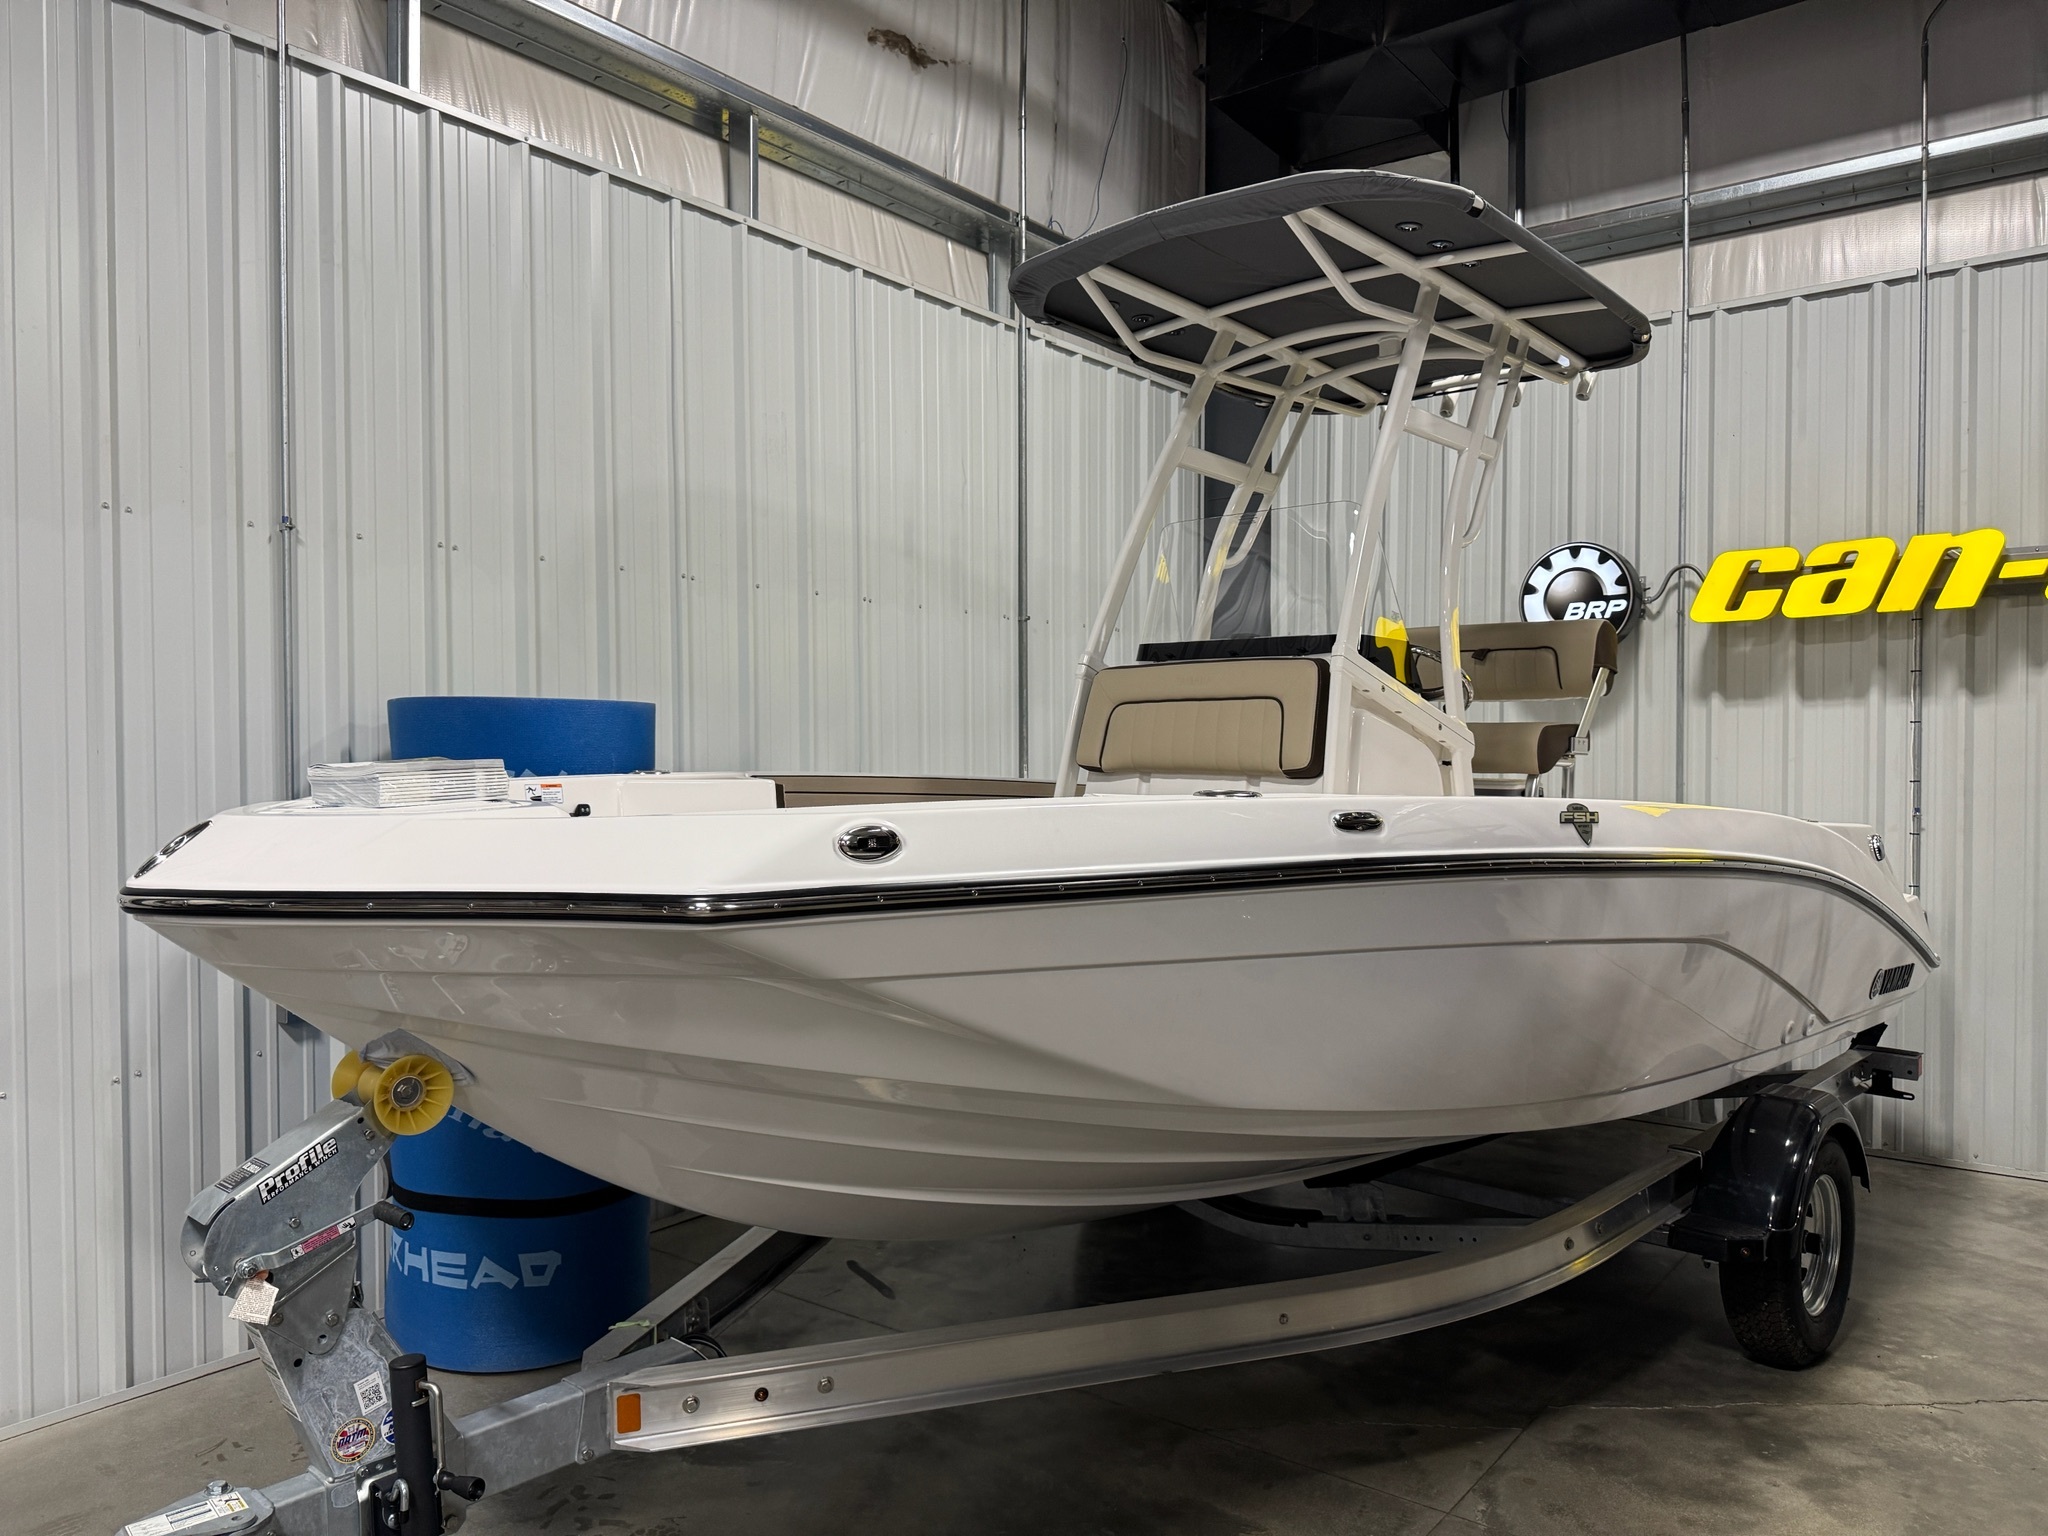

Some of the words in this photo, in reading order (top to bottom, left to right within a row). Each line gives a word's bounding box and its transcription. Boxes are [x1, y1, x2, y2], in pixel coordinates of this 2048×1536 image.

[1691, 528, 2048, 623] can-
[1563, 599, 1628, 621] BRP
[1560, 812, 1599, 822] FSH
[258, 1138, 337, 1199] Profile
[262, 1165, 313, 1204] PERFORMANCE
[314, 1149, 338, 1168] WINCH
